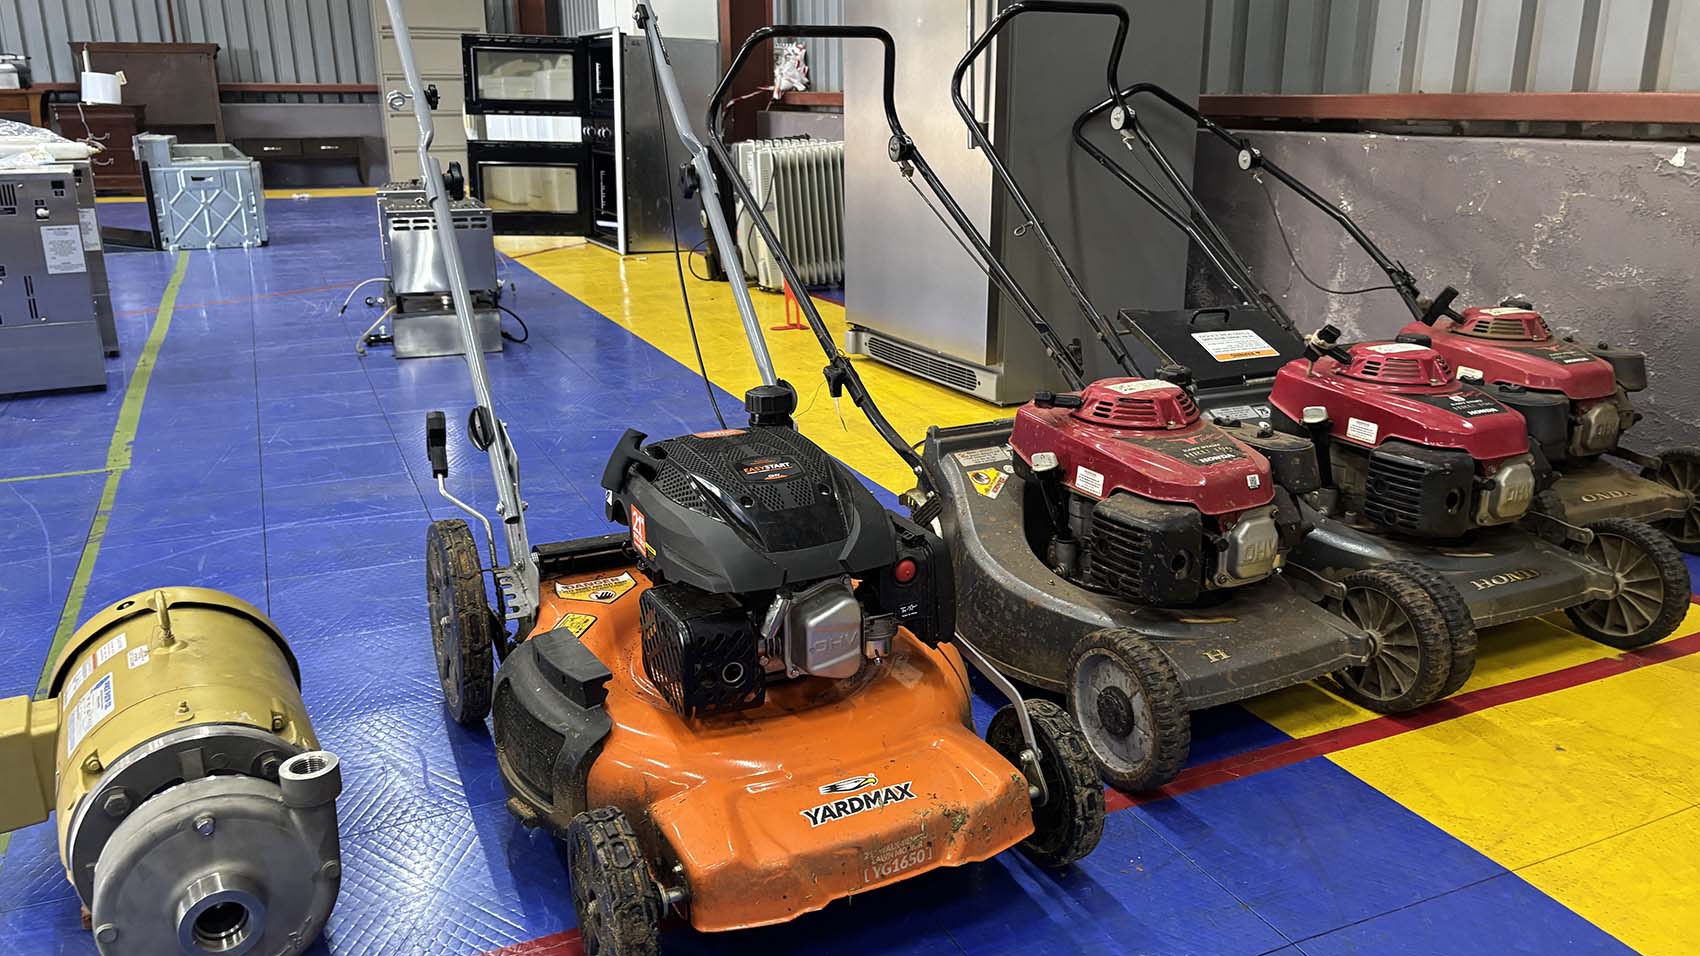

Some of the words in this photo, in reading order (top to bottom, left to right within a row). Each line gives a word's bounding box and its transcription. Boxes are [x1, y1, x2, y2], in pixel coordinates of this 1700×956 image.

[1199, 453, 1236, 463] HONDA
[803, 782, 914, 826] YARDMAX
[872, 849, 925, 880] YG1650
